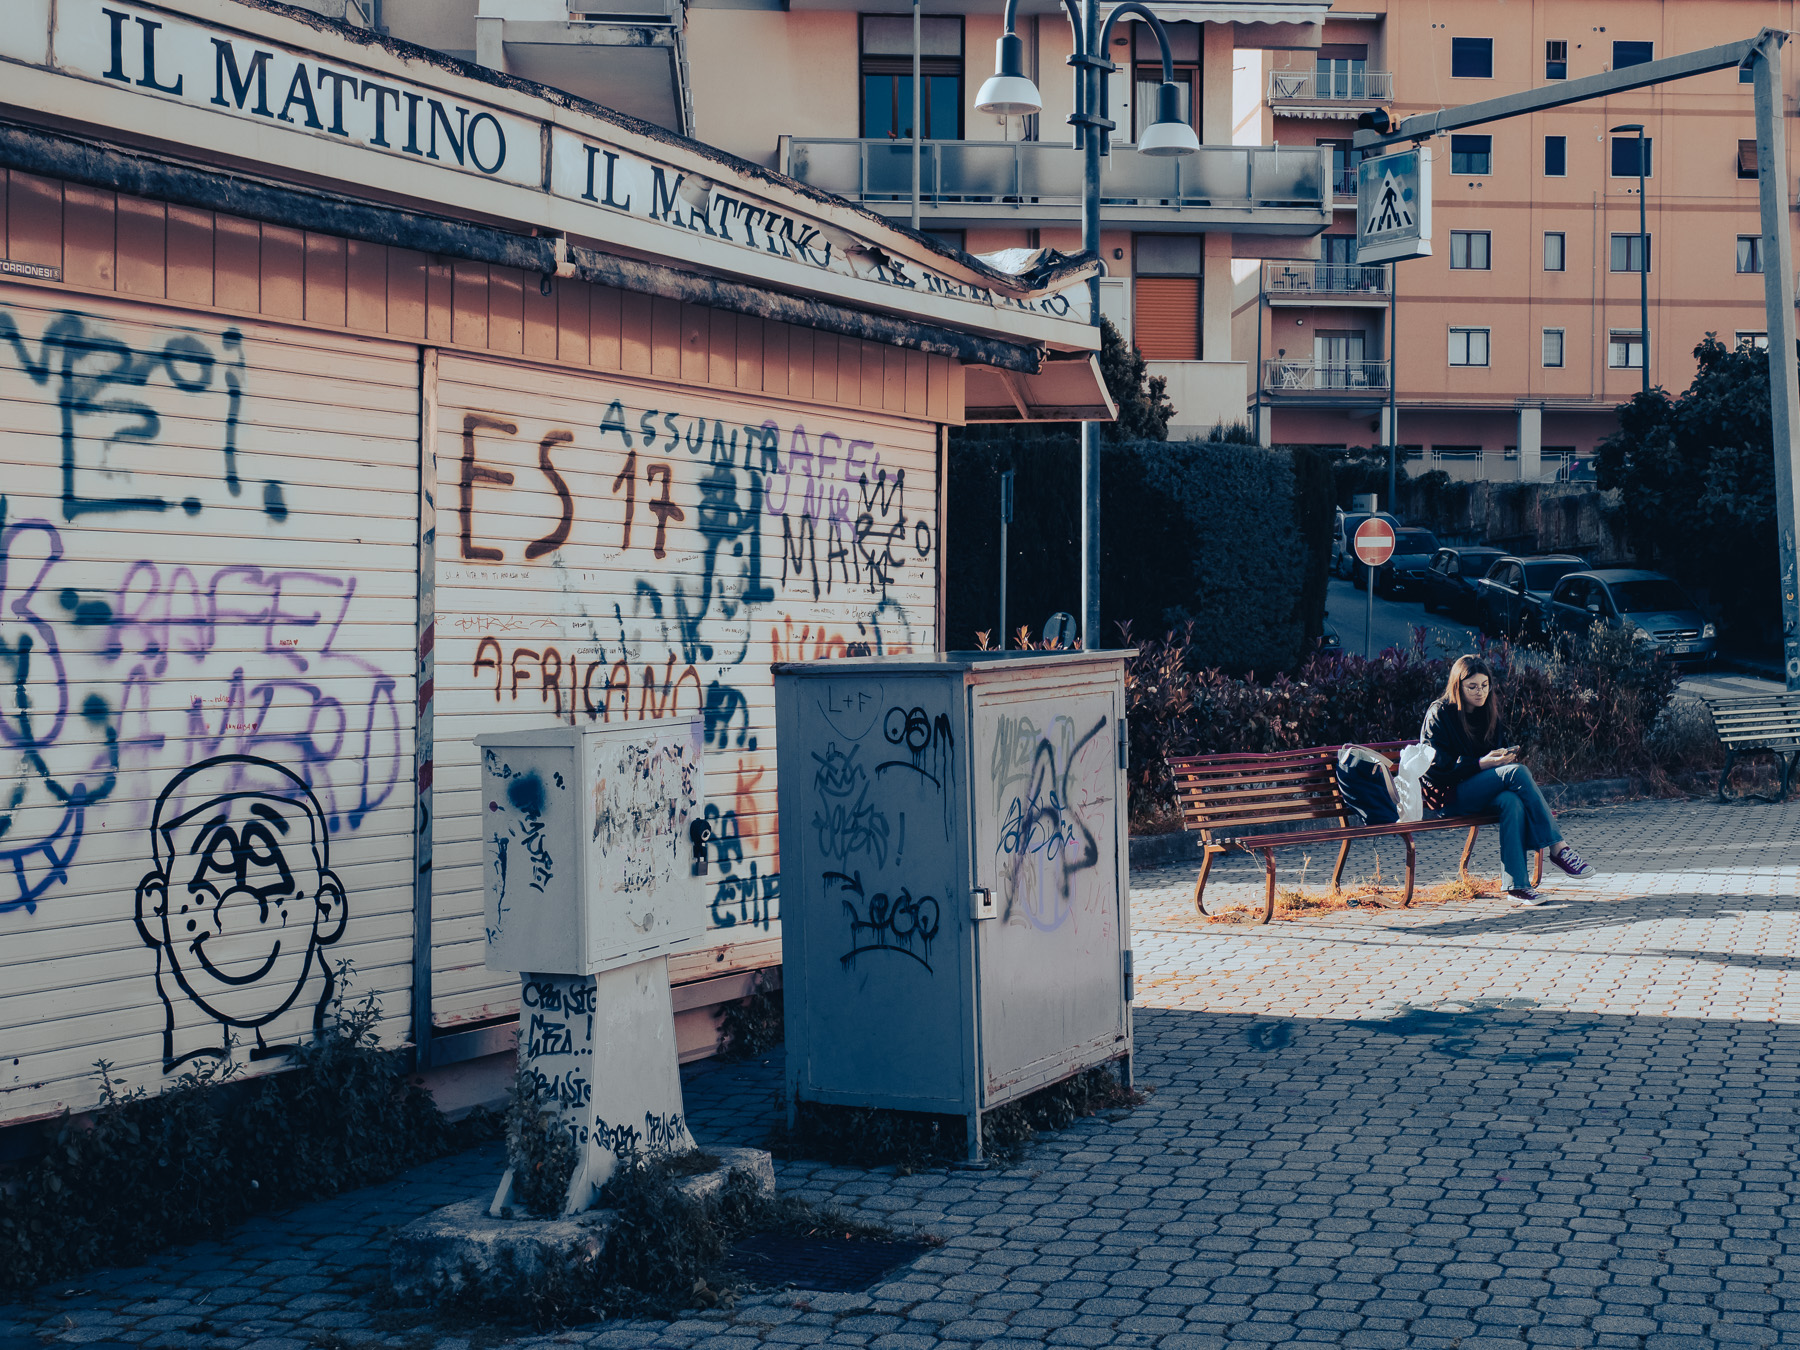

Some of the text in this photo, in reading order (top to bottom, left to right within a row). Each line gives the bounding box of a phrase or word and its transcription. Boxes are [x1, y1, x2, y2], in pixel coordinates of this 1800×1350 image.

[102, 7, 507, 175] IL MATTINO
[581, 143, 631, 212] IL
[460, 412, 574, 560] ES
[600, 399, 778, 474] ASSUNTA
